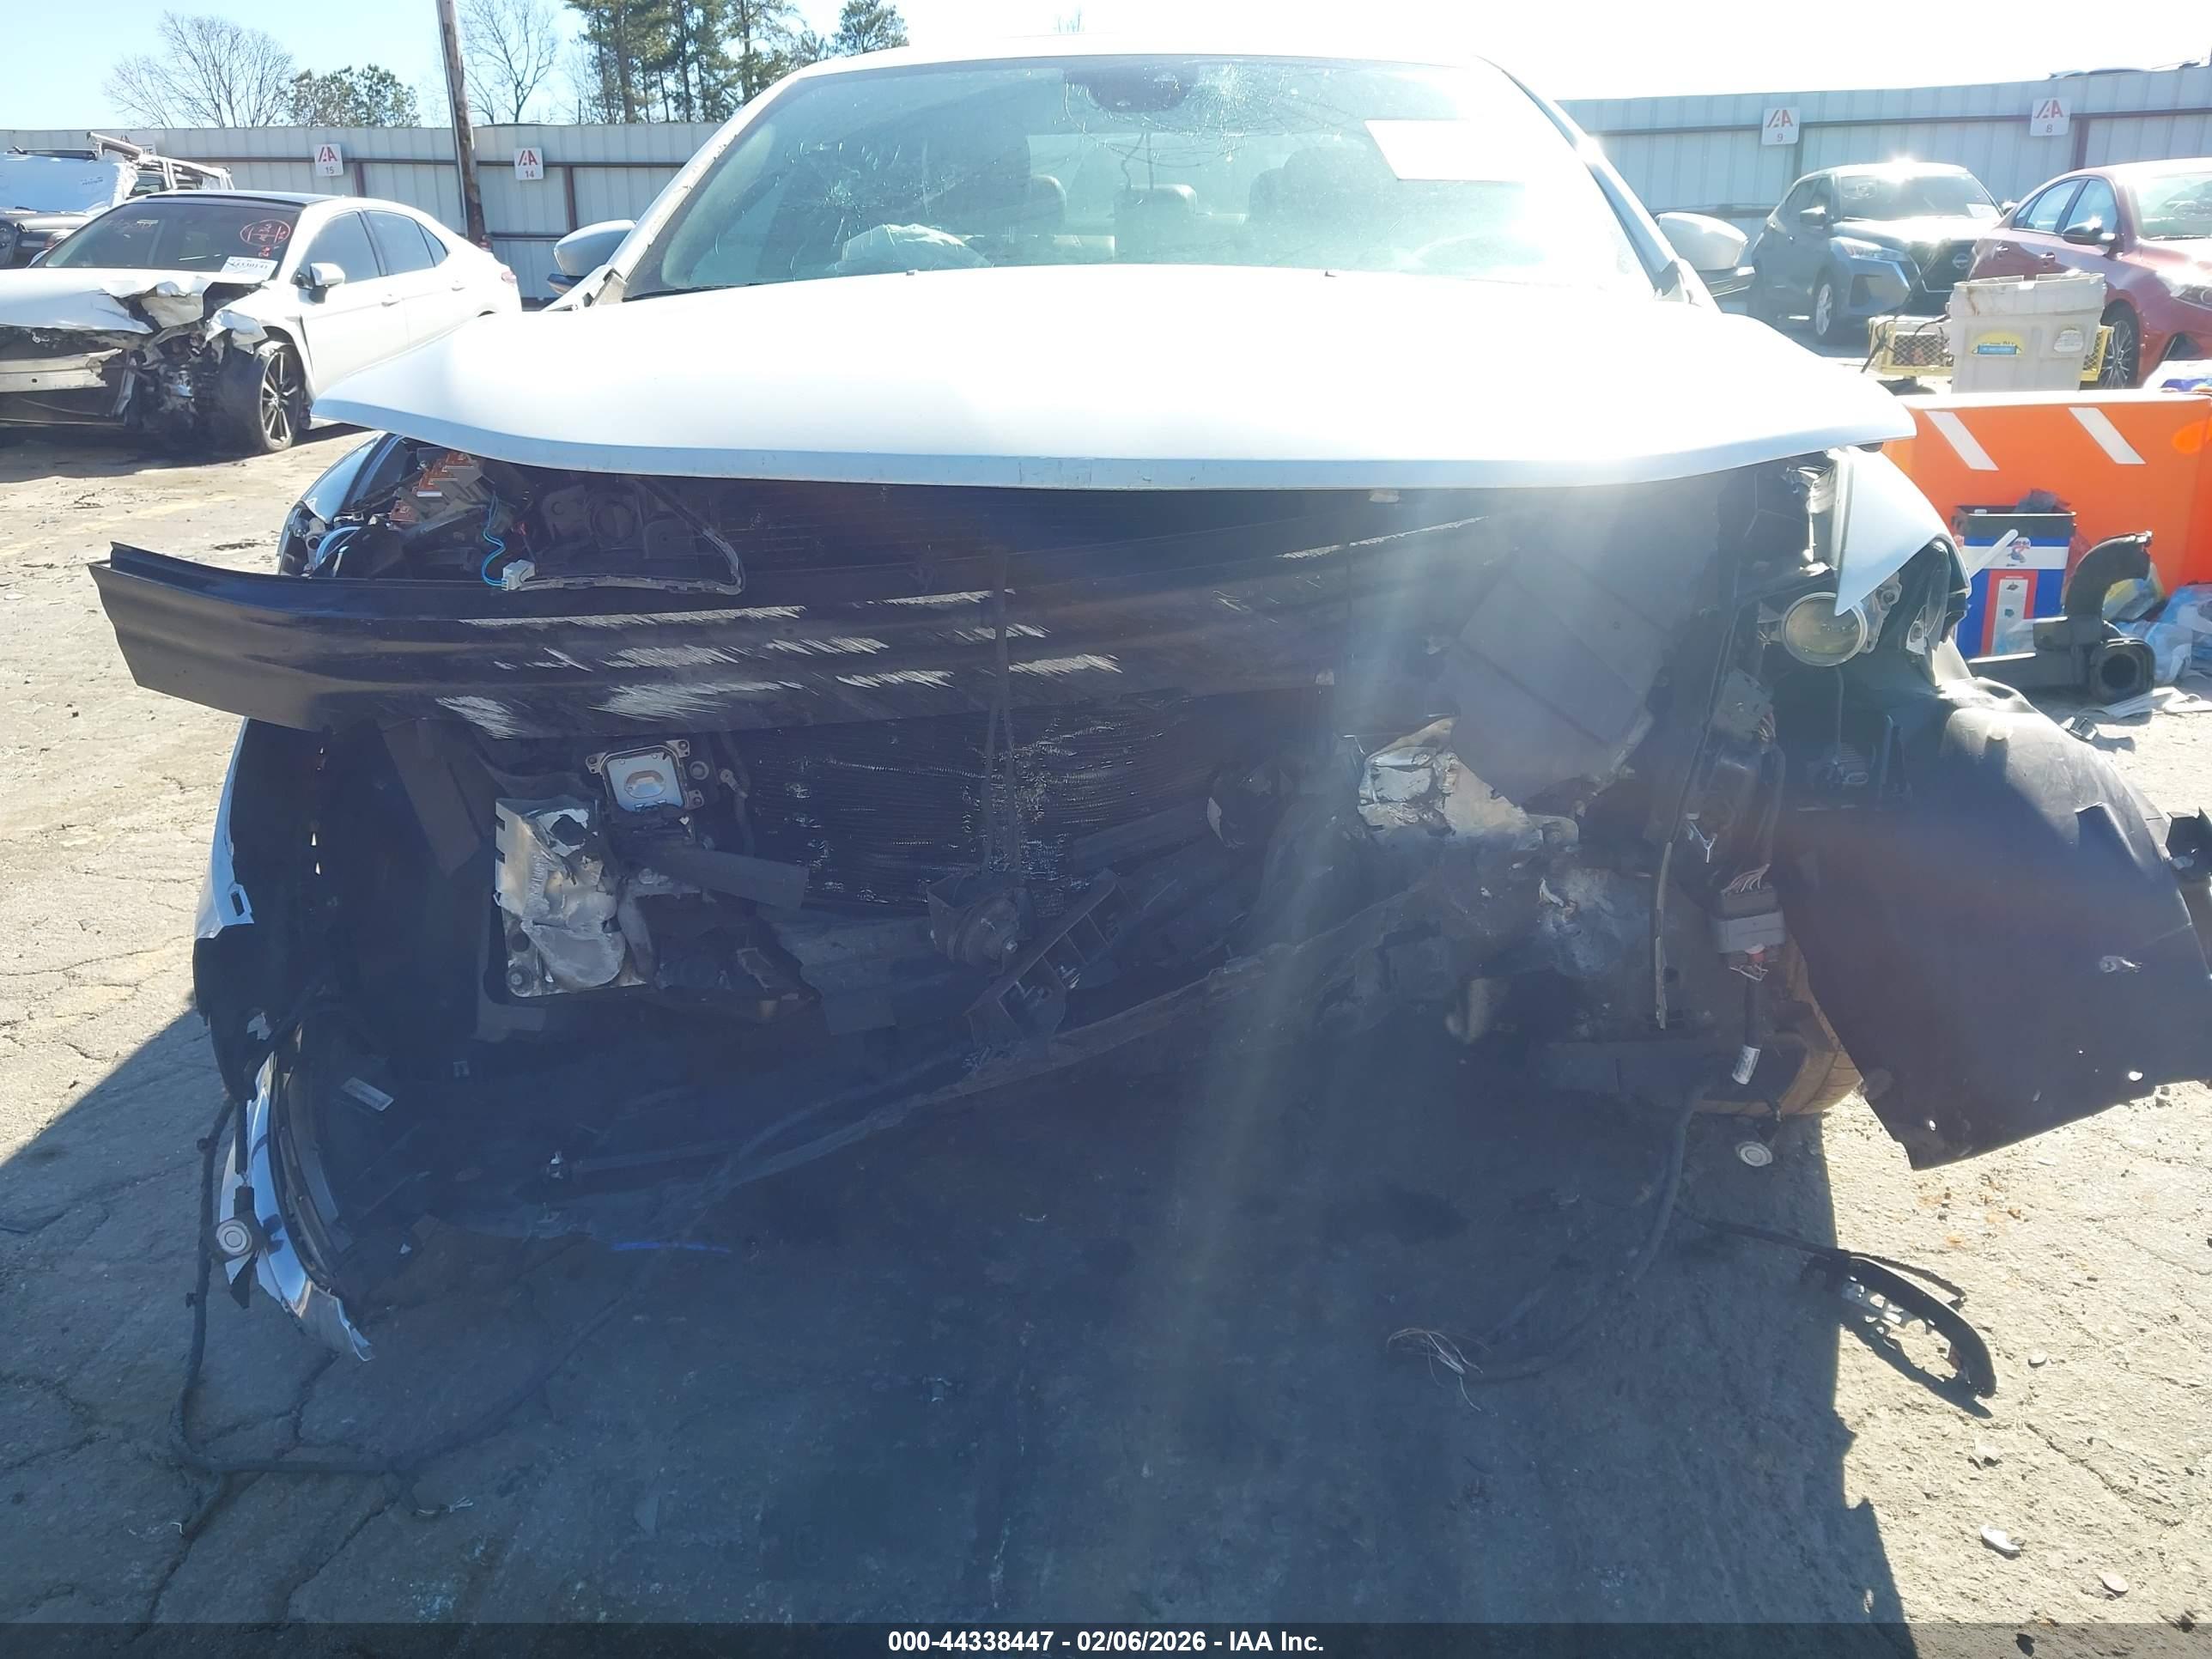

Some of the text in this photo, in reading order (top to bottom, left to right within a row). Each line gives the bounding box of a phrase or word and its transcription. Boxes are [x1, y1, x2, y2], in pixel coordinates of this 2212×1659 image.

[2046, 124, 2053, 133] 8
[1777, 133, 1784, 142] 9
[325, 166, 335, 174] 15
[525, 170, 535, 179] 14
